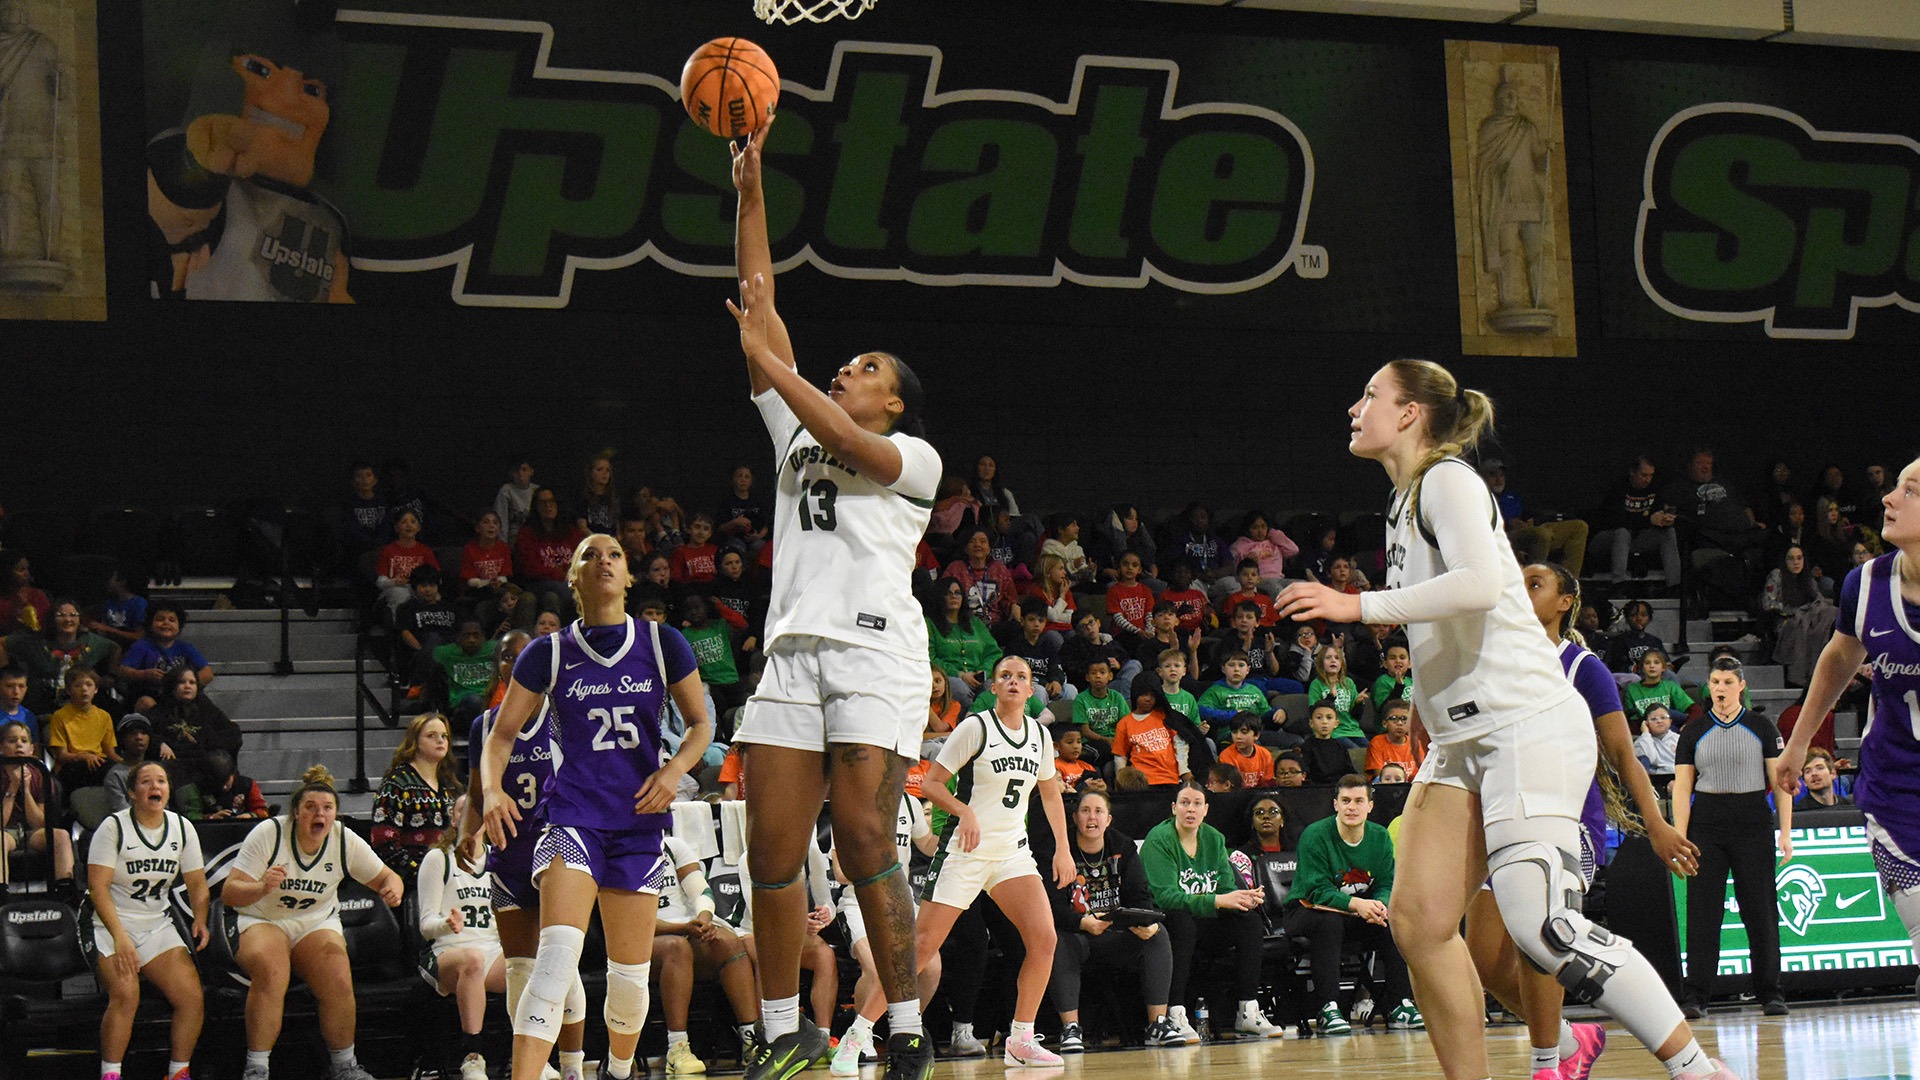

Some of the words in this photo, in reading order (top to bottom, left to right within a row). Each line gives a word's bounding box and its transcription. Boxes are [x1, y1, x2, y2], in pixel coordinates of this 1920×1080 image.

[338, 42, 1290, 276] Upstate
[1661, 133, 1920, 309] Sp
[1300, 253, 1320, 270] TM
[799, 479, 838, 531] 13
[1872, 652, 1920, 680] Agnes
[566, 678, 613, 701] Agnes
[617, 675, 653, 693] Scott
[587, 705, 641, 751] 25
[530, 746, 552, 762] Sco
[991, 756, 1040, 777] UPSTATE
[516, 772, 537, 809] 3
[1002, 779, 1025, 810] 5
[126, 858, 177, 876] UPSTATE
[130, 878, 168, 902] 24
[280, 878, 327, 895] UPSTATE
[8, 909, 62, 924] Upstate
[461, 905, 491, 928] 33
